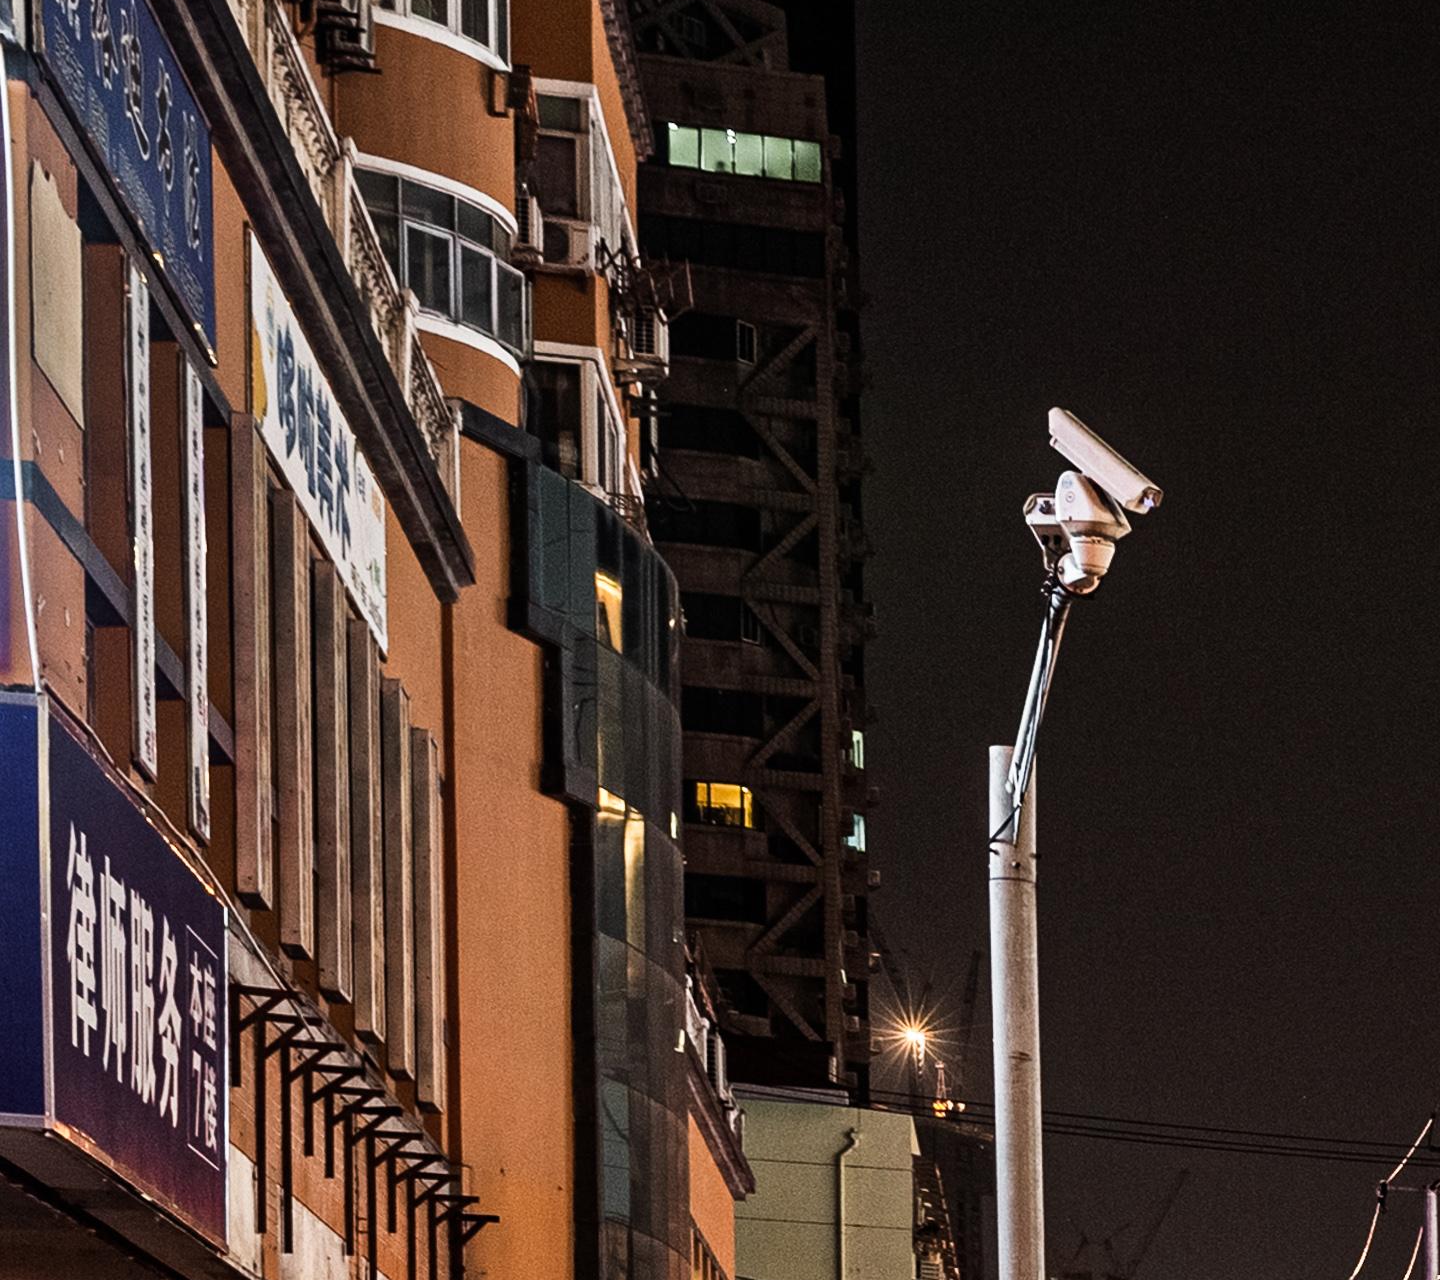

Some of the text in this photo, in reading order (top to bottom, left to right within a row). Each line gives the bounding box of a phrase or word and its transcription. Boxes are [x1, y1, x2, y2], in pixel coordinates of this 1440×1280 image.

[67, 820, 182, 1128] 律师服务
[189, 954, 217, 1052] 本座
[192, 1052, 217, 1152] 7楼
